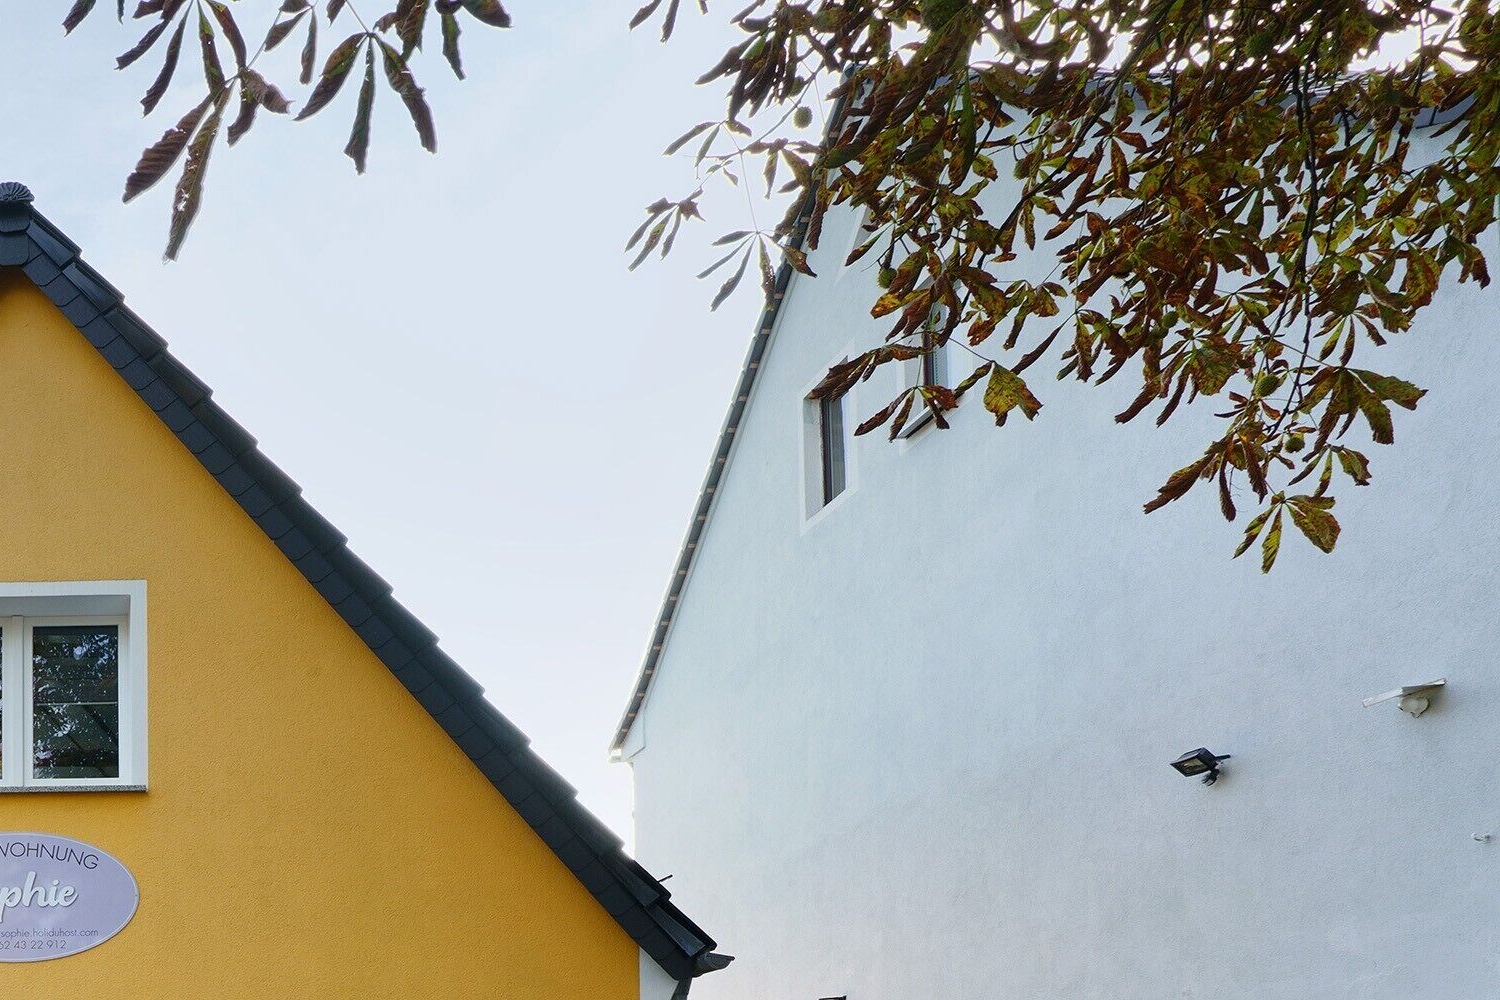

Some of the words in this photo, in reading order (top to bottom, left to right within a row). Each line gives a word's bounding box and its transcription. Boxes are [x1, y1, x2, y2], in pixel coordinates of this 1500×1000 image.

[13, 940, 27, 950] 43
[29, 940, 44, 950] 22
[46, 939, 67, 950] 912
